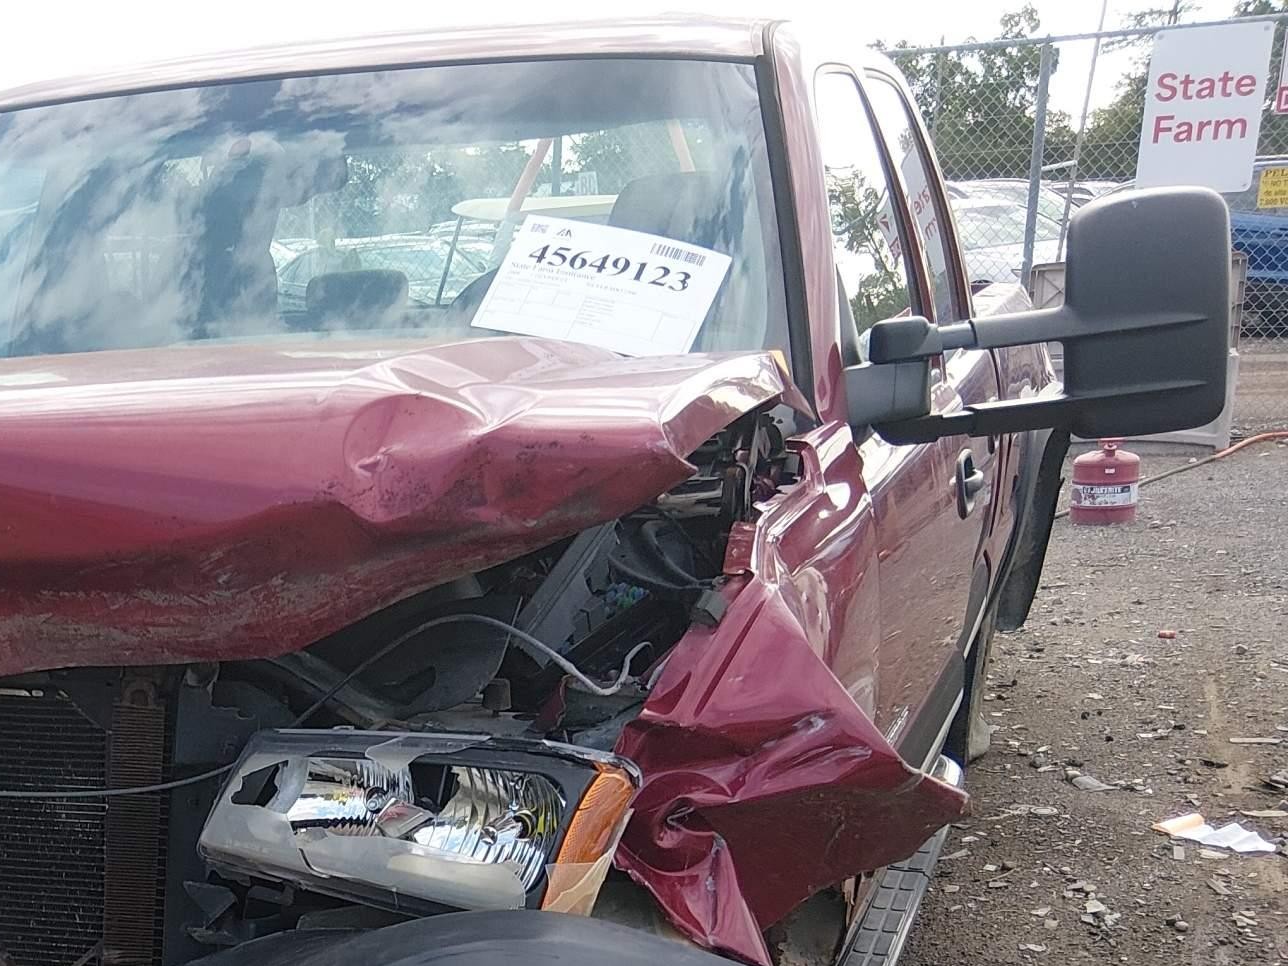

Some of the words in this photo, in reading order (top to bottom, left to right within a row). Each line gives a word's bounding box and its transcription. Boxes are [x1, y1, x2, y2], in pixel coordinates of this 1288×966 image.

[1155, 71, 1257, 102] State
[1152, 115, 1248, 144] Farm
[528, 244, 692, 292] 45649123
